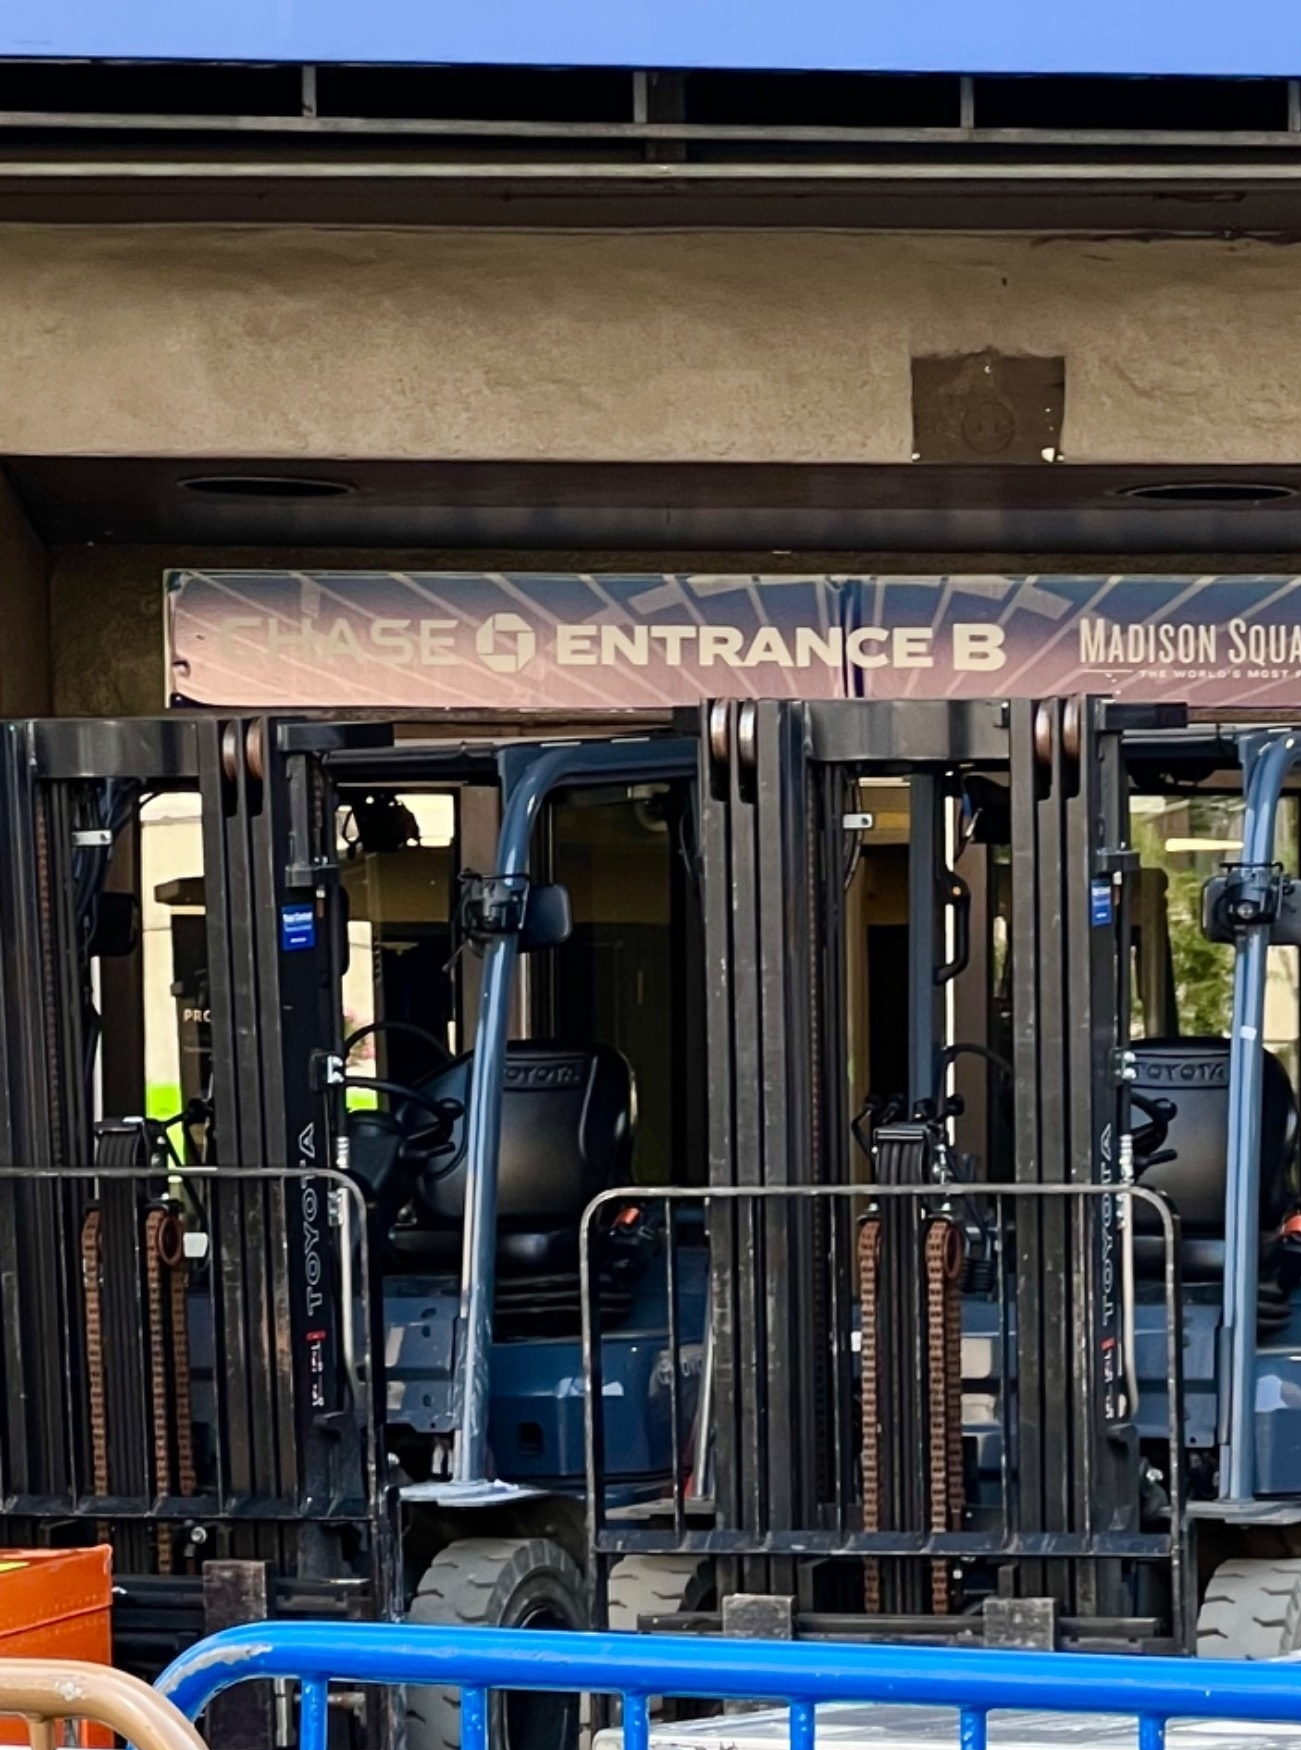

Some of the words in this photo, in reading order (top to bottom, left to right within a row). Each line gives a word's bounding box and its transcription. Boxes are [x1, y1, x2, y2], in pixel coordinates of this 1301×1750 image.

[219, 617, 460, 665] CHASE
[556, 624, 934, 667] ENTRANCE
[952, 623, 1007, 671] B
[1139, 669, 1167, 679] THE
[1247, 669, 1289, 679] MOST
